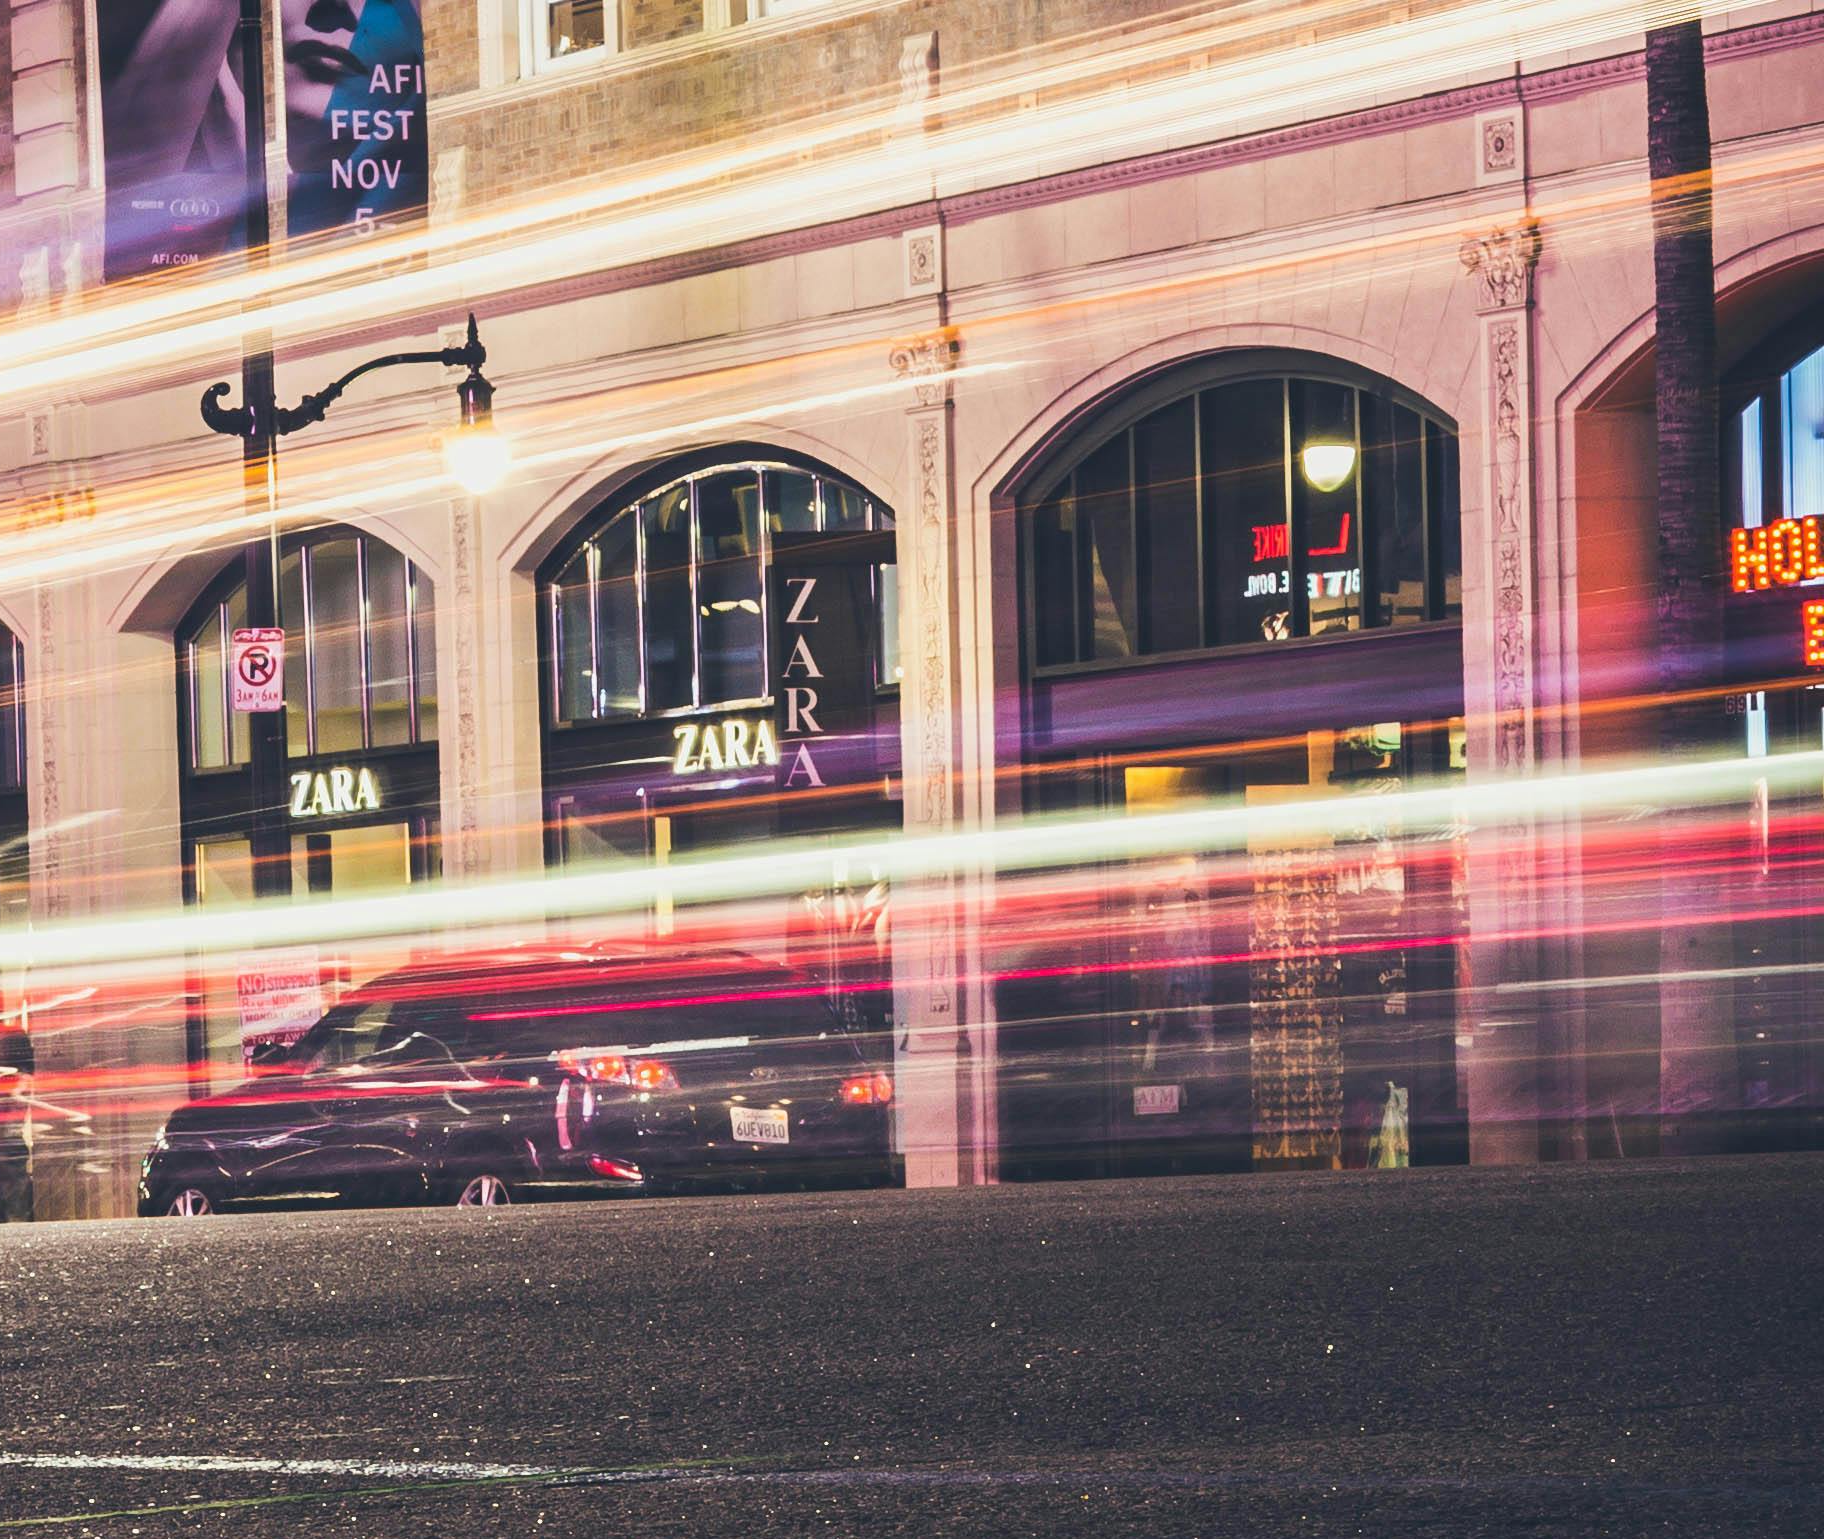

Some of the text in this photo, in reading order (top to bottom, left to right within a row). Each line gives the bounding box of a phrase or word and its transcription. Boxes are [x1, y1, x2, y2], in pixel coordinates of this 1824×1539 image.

[368, 63, 423, 94] AFI
[330, 109, 414, 141] FEST
[331, 158, 402, 190] NOV
[151, 253, 199, 265] AFI.COM
[781, 577, 827, 788] ZARA
[672, 718, 781, 775] ZARA
[289, 766, 381, 818] ZARA
[240, 975, 264, 995] NO
